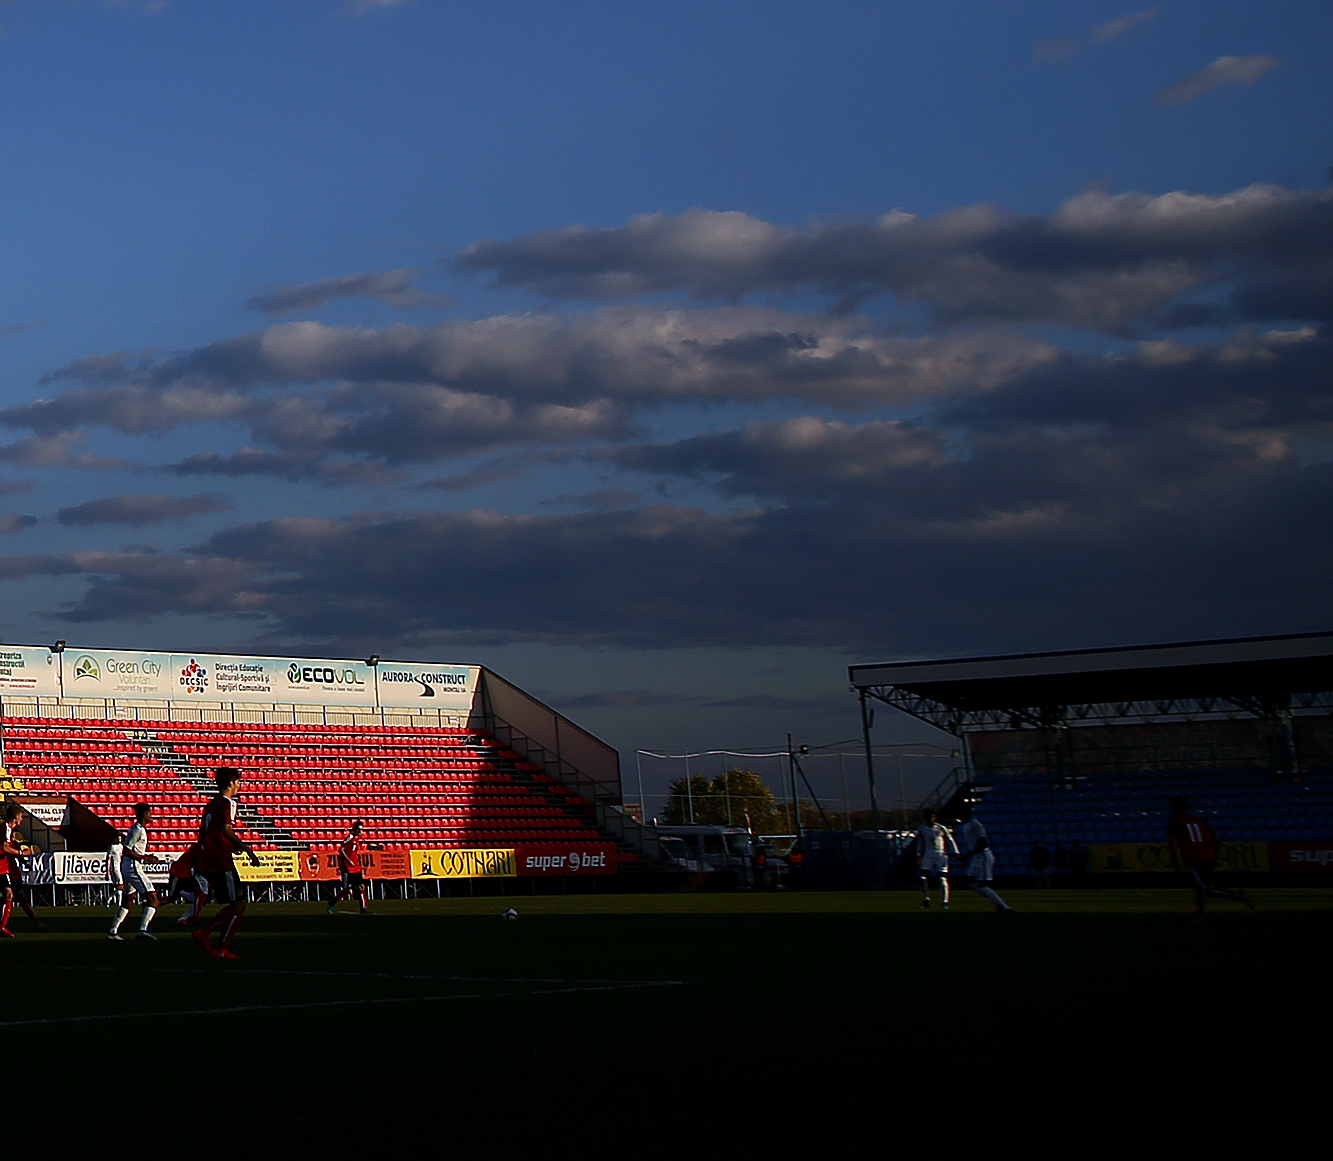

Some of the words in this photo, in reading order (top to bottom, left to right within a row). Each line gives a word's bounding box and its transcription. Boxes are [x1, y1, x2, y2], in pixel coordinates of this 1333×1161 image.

[106, 658, 139, 673] Green
[141, 659, 161, 677] City
[302, 667, 365, 684] ECOVOL
[180, 677, 209, 686] DECSIC
[382, 671, 414, 682] AURORA
[421, 672, 466, 684] CONSTRUCT
[1185, 822, 1203, 842] 11
[526, 855, 567, 871] super
[583, 852, 605, 867] bet
